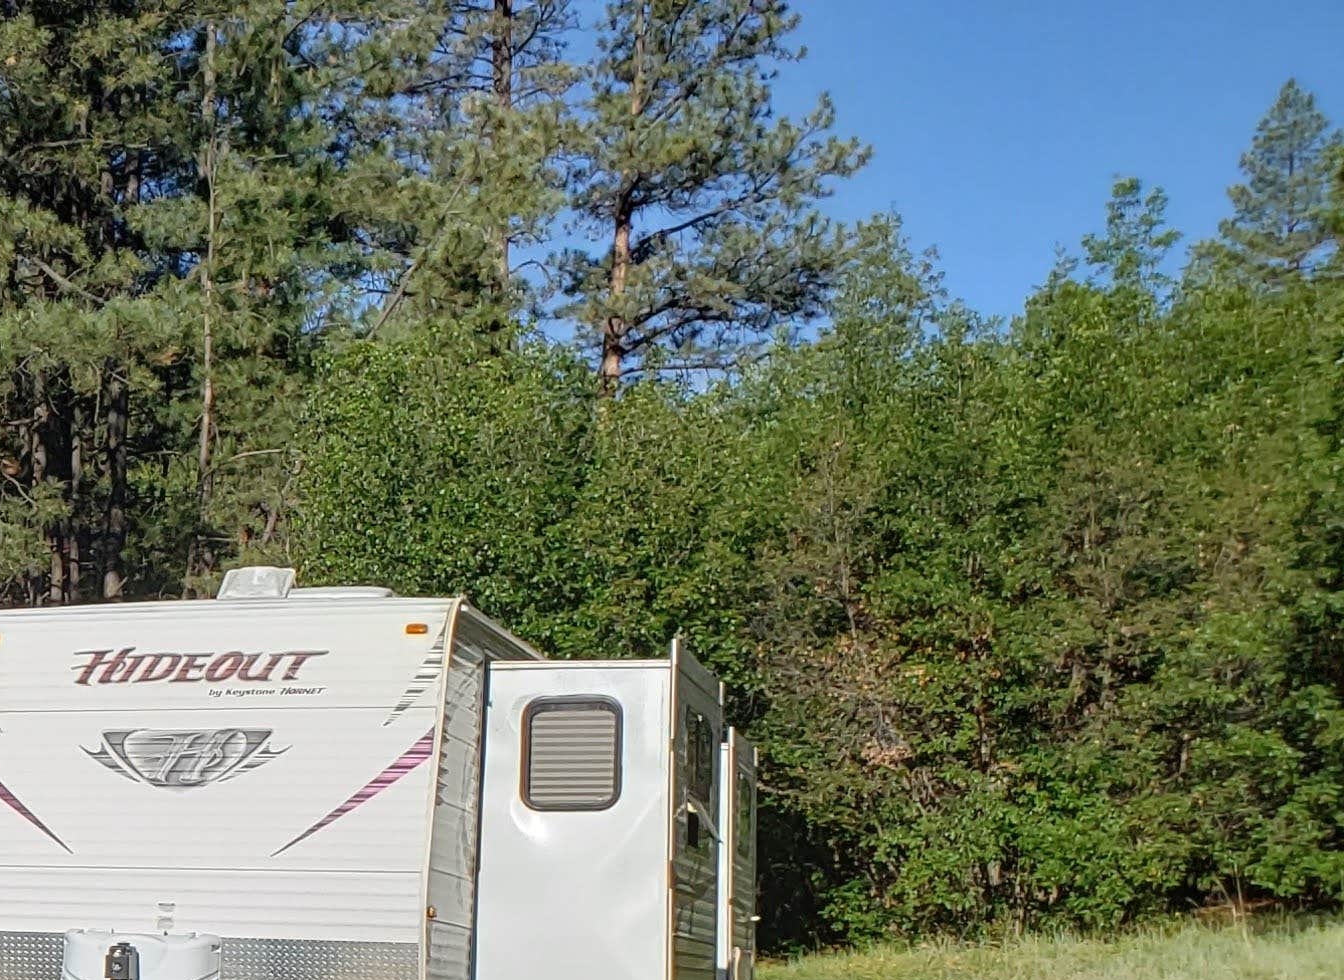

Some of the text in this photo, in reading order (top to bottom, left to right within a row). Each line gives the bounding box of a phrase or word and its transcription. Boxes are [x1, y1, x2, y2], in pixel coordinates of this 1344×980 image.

[71, 646, 330, 686] HIDEOUT
[208, 687, 327, 698] by Keystone HORNET
